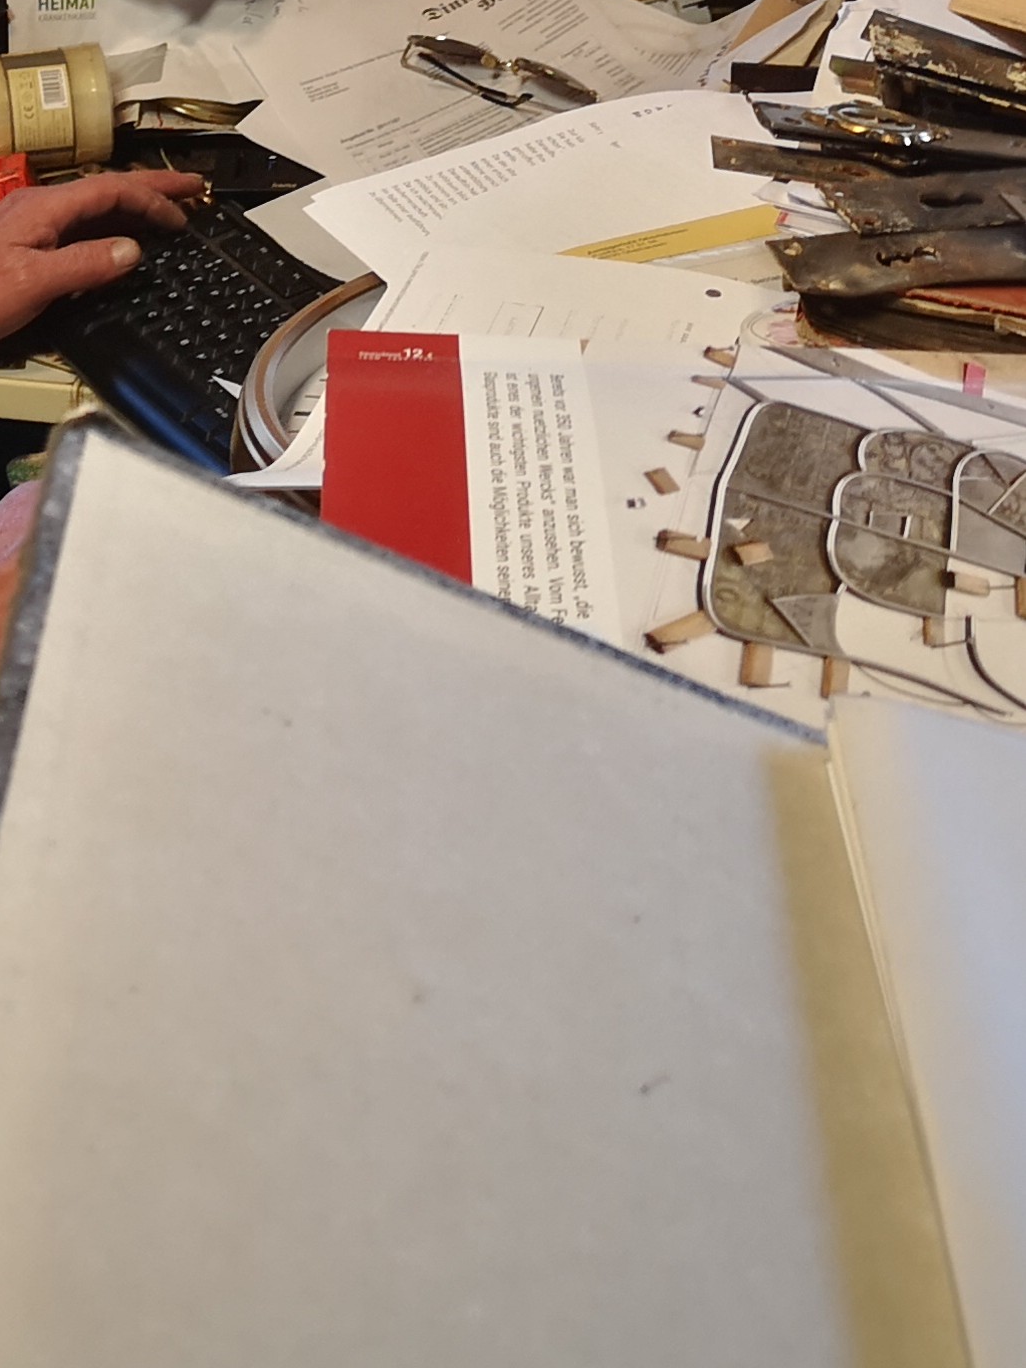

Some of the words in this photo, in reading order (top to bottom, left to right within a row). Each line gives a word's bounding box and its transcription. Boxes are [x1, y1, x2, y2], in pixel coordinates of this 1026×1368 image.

[510, 405, 524, 420] der
[554, 399, 567, 411] vor
[487, 421, 504, 441] sind
[556, 413, 572, 431] 350
[489, 442, 505, 467] auch
[509, 423, 528, 477] wichtigsten
[557, 432, 576, 464] Jahren
[490, 468, 506, 484] die
[562, 466, 575, 485] war
[517, 480, 533, 530] Produkte
[565, 488, 579, 512] man
[490, 486, 510, 563] Möglichkeiten
[567, 514, 584, 537] sich
[522, 534, 535, 580] unseres
[548, 577, 567, 605] Vom
